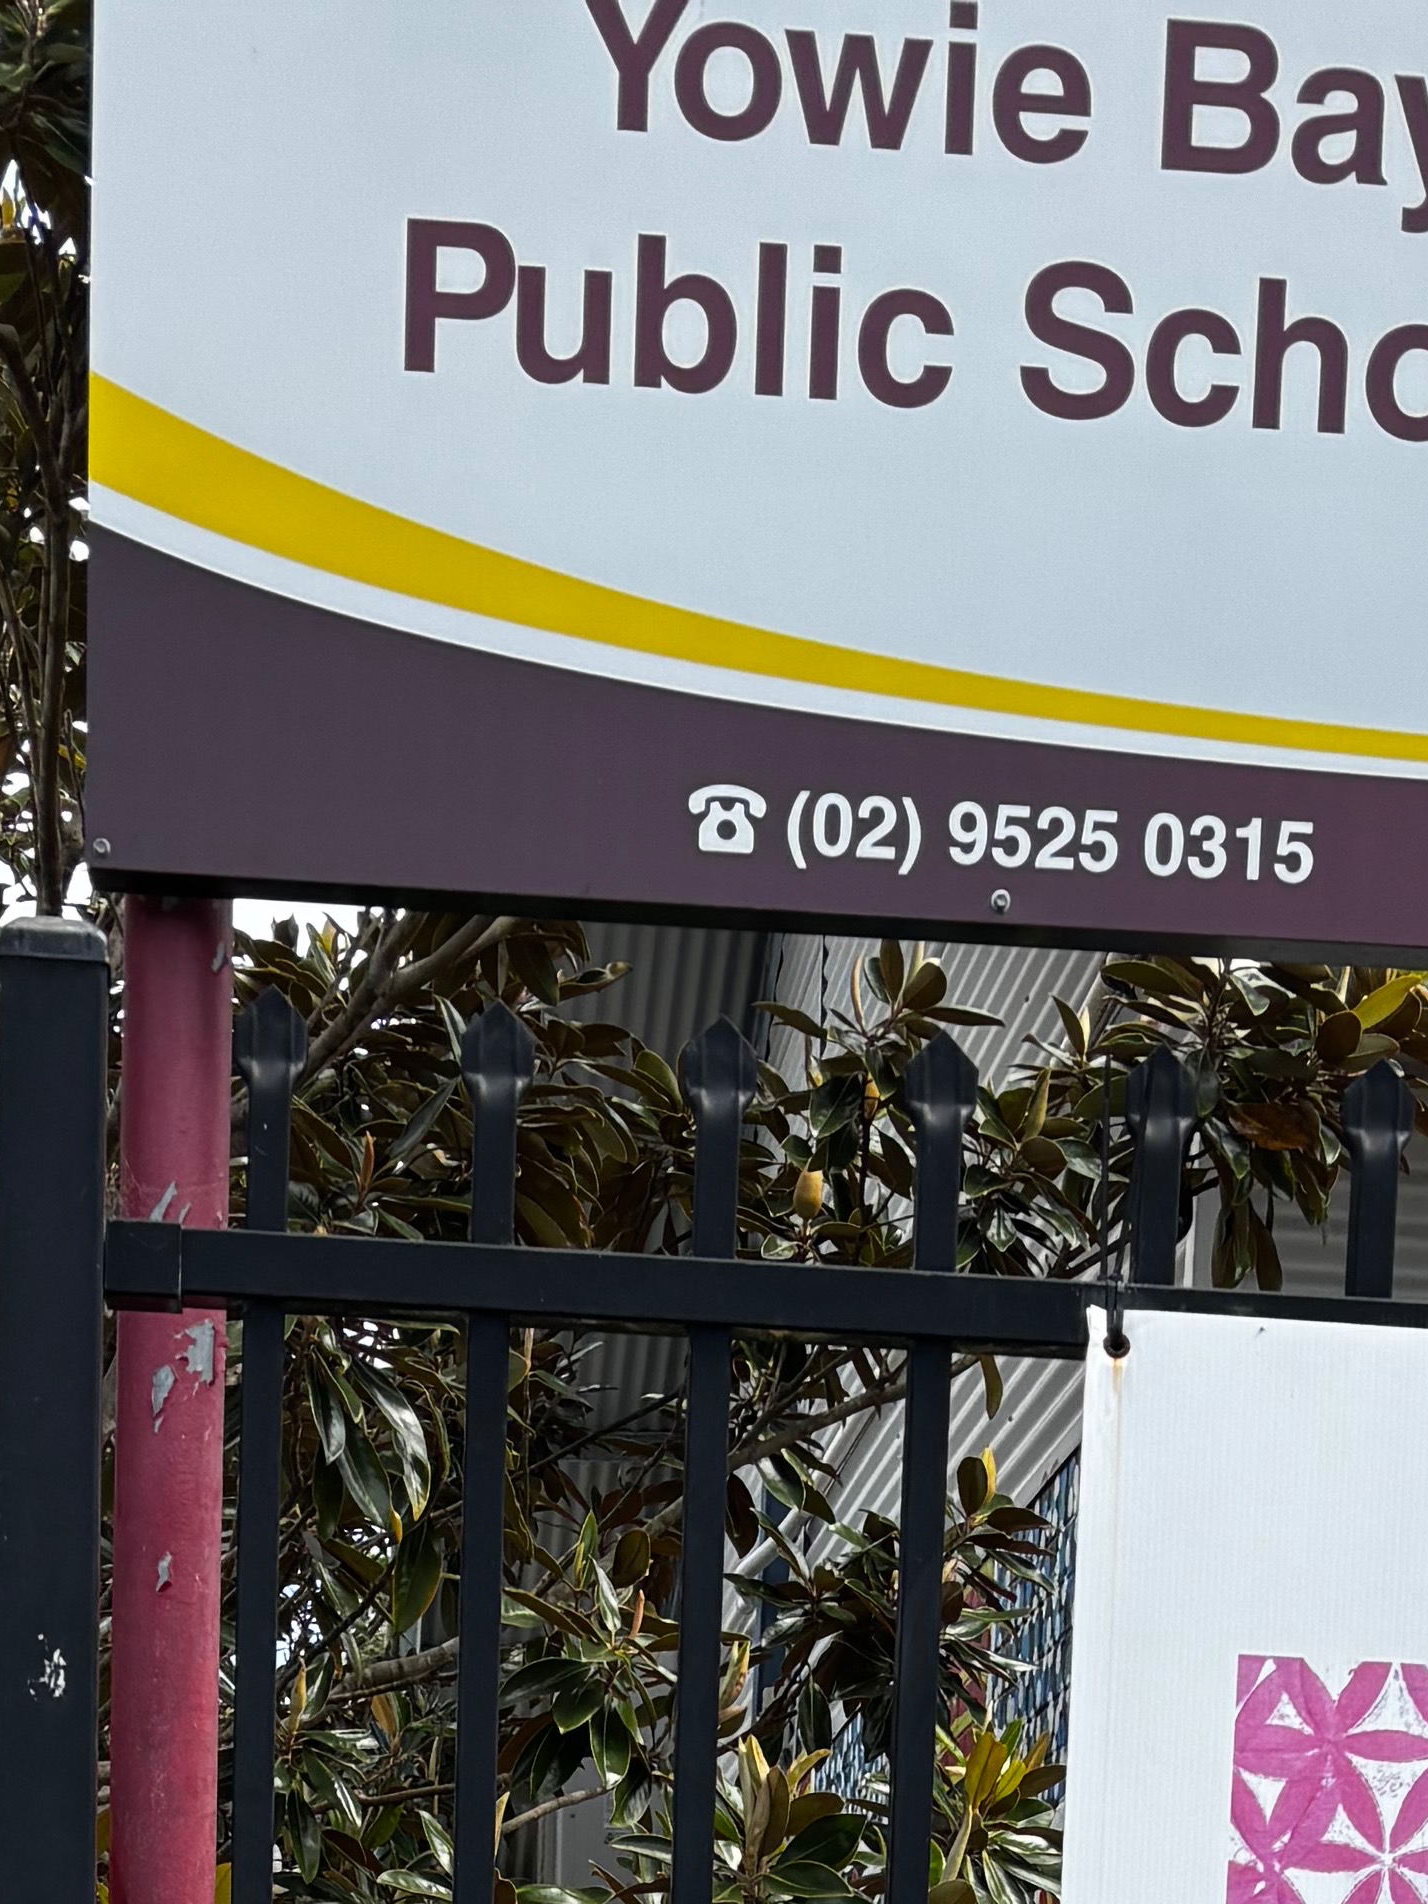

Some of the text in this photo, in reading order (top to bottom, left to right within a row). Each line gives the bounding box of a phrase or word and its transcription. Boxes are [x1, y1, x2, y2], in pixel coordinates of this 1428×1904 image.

[586, 0, 1091, 164] Yowie
[404, 218, 954, 408] Public
[788, 791, 1313, 884] (02) 9525 0315
